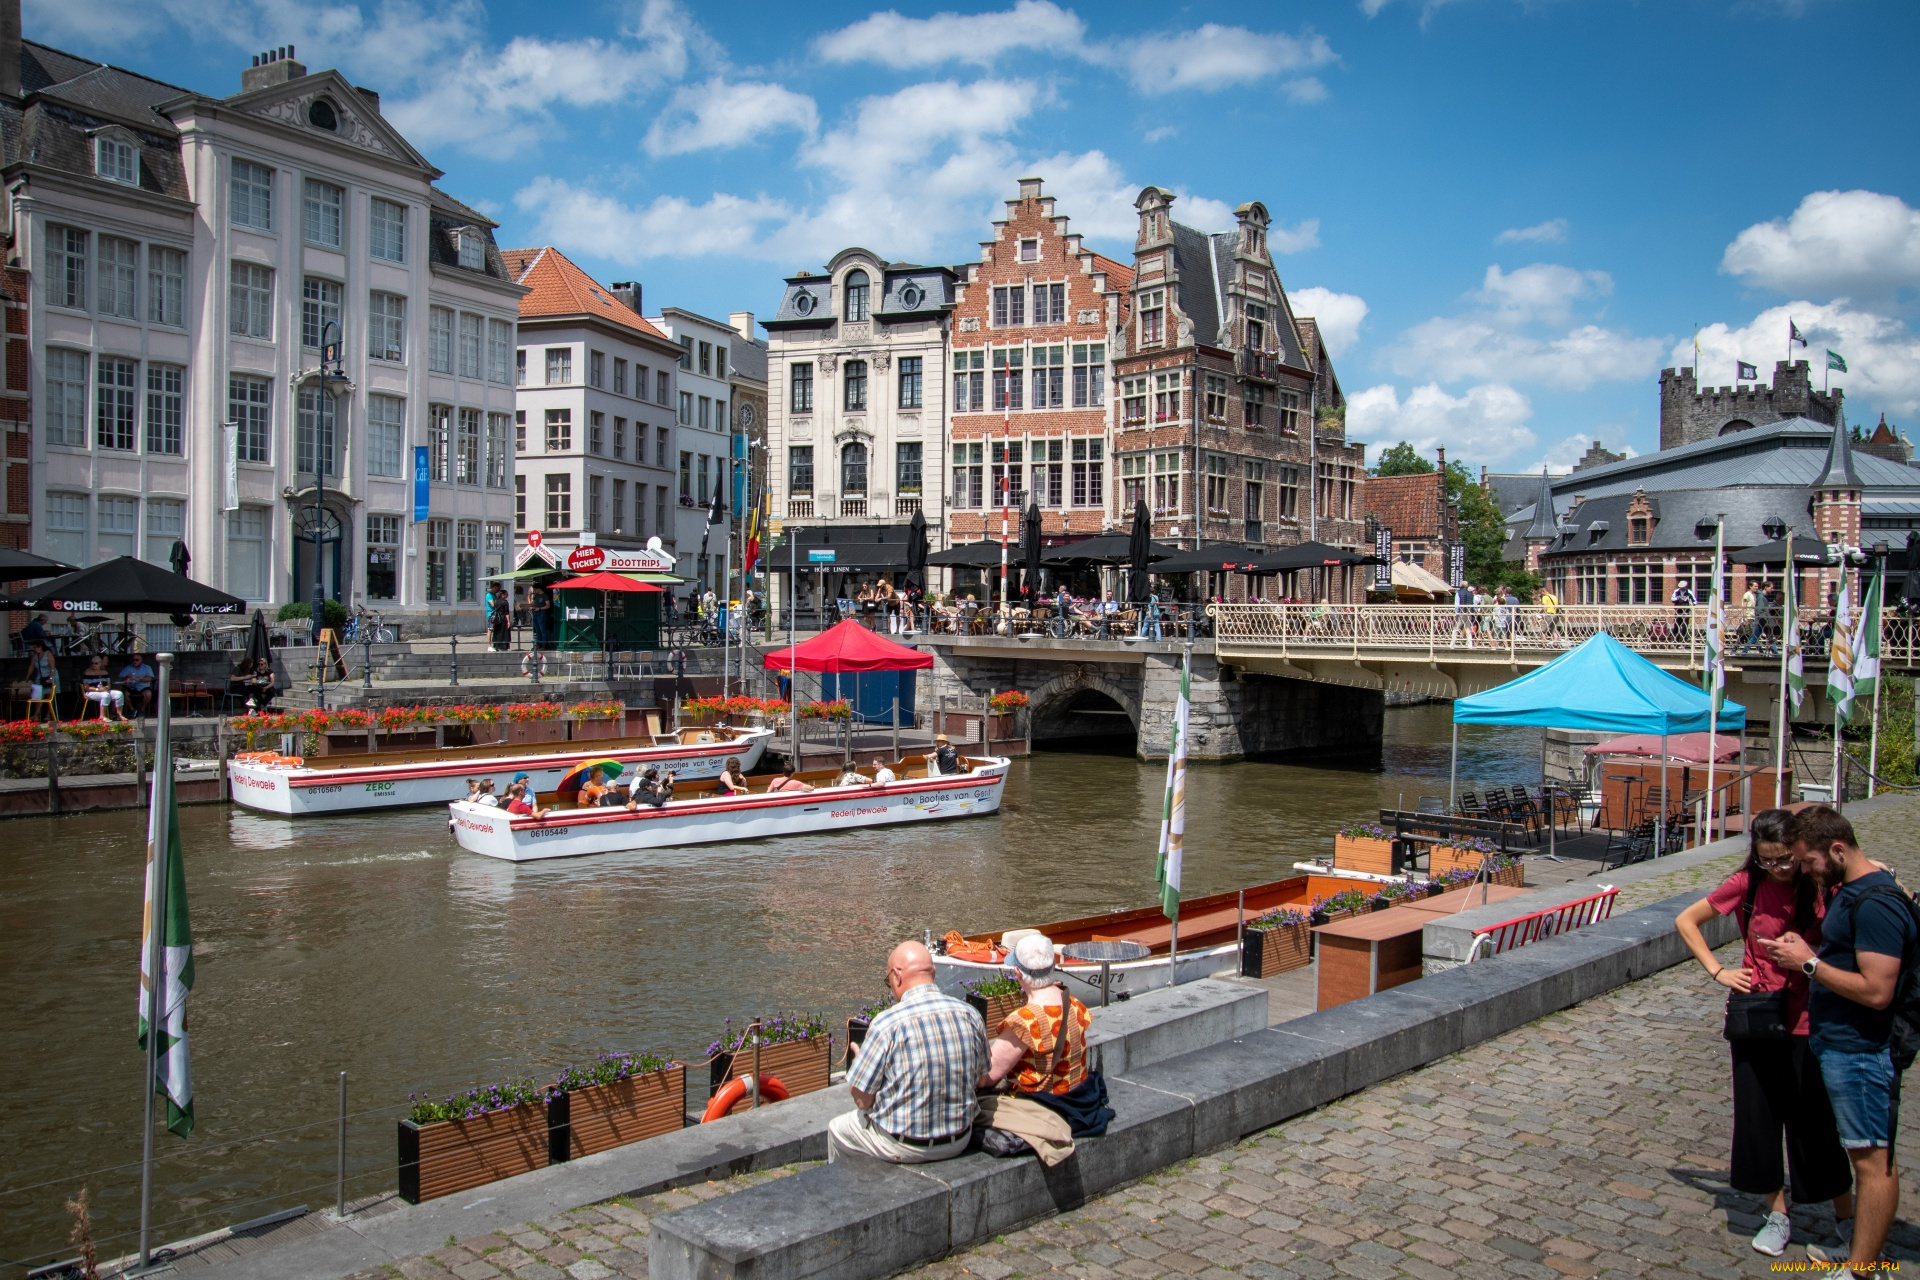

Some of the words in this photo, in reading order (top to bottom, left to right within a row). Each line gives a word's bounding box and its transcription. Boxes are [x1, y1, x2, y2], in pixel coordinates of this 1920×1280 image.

[576, 548, 595, 558] HIER
[572, 557, 602, 569] TICKETS
[191, 603, 238, 612] Meraki
[248, 776, 275, 790] Dewaele
[903, 797, 914, 805] De
[920, 792, 950, 804] Bootjes
[974, 790, 991, 798] Gent
[831, 809, 855, 818] Rederij
[857, 806, 887, 815] Dewaele
[467, 820, 493, 833] Dewaele
[530, 828, 568, 838] 06105449
